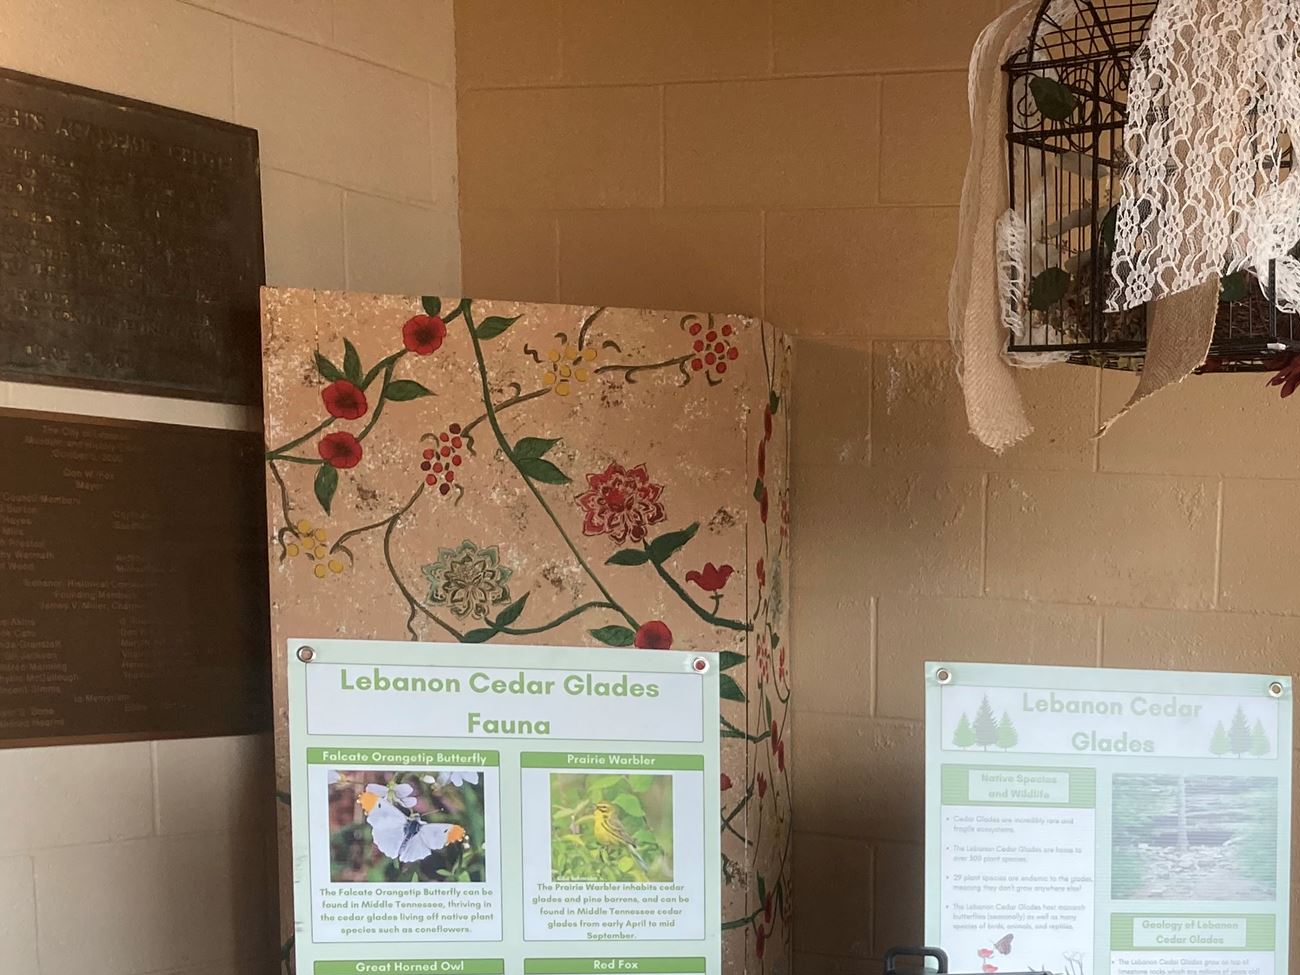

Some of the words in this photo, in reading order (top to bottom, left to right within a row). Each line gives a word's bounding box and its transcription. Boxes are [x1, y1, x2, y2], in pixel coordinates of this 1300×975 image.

[340, 669, 460, 693] Lebanon
[470, 671, 555, 695] Cedar
[563, 673, 659, 697] Glades
[14, 683, 155, 717] Glades
[1023, 693, 1122, 716] Lebanon
[1130, 695, 1202, 718] Cedar
[468, 713, 550, 734] Fauna
[1072, 732, 1155, 753] Glades
[322, 752, 368, 763] Falcate
[372, 752, 434, 765] Orangetip
[437, 753, 486, 766] Butterfly
[568, 754, 605, 765] Prairie
[609, 755, 656, 765] Warbler
[981, 774, 1014, 783] Native
[1016, 774, 1056, 785] Species
[988, 789, 1008, 798] and
[1011, 790, 1049, 799] Wildlife
[376, 888, 421, 897] Orangetip
[424, 888, 460, 897] Butterfly
[448, 901, 481, 909] thriving
[532, 896, 561, 904] glades
[584, 896, 601, 904] pine
[367, 914, 397, 922] glades
[400, 914, 423, 922] living
[471, 914, 493, 922] plant
[548, 920, 577, 928] glades
[602, 920, 623, 928] early
[626, 920, 646, 928] April
[1142, 920, 1183, 931] Geology
[1186, 920, 1195, 929] of
[1197, 920, 1238, 929] Lebanon
[341, 926, 376, 934] species
[1156, 935, 1186, 943] Cedar
[356, 962, 390, 972] Great
[394, 961, 437, 972] Horned
[440, 961, 464, 971] Owl
[594, 960, 615, 969] Red
[619, 960, 638, 969] Fox
